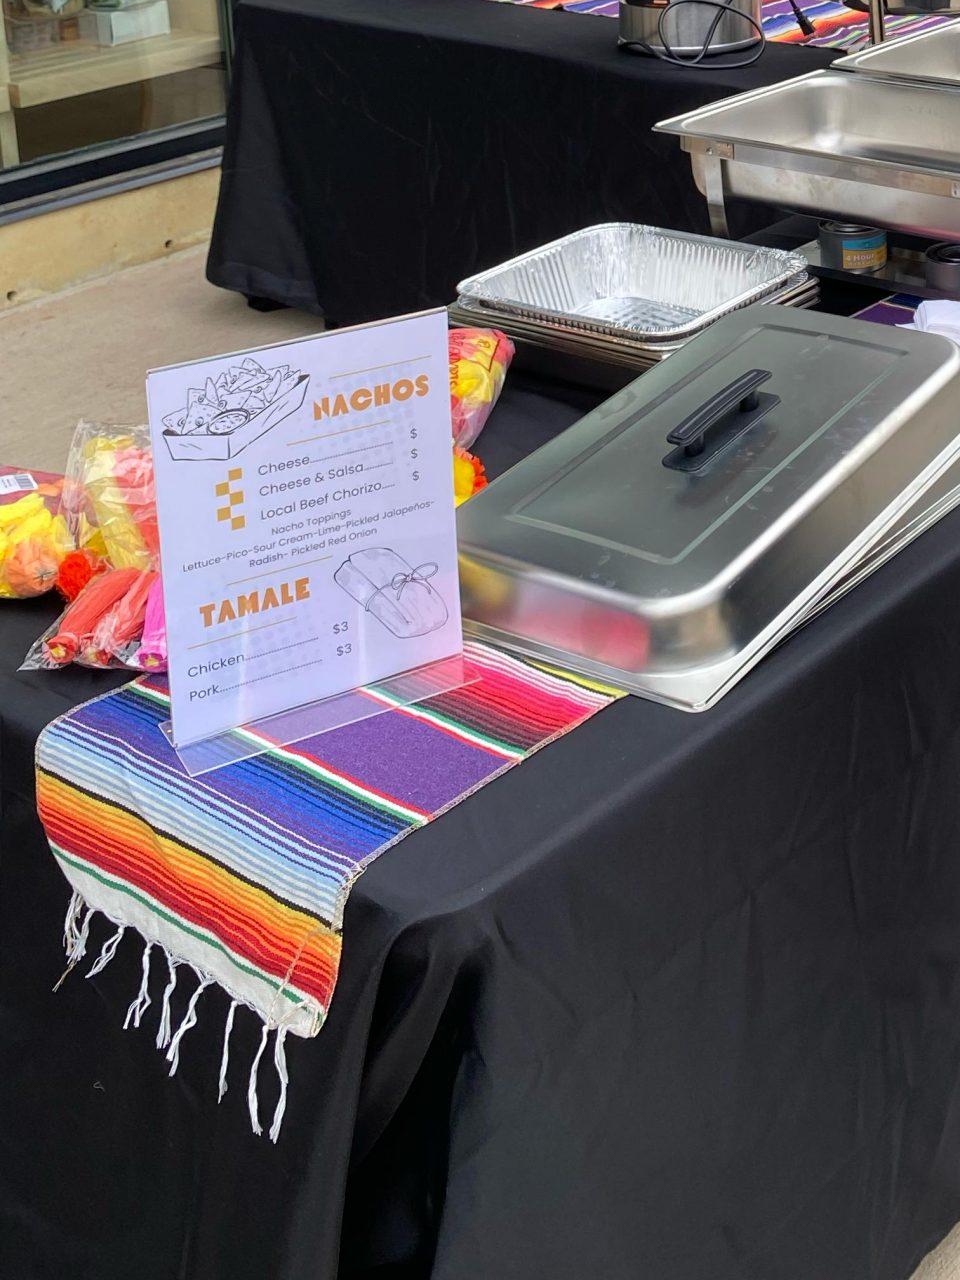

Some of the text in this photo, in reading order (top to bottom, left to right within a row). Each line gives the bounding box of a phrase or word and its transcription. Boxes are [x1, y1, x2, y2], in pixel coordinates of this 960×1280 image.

[313, 374, 429, 421] NACHOS
[258, 427, 418, 476] Cheese $
[259, 448, 418, 497] Cheese & Salsa $
[260, 470, 420, 521] Local Beef Chorizo $
[271, 509, 352, 535] Nacho Toppings
[249, 527, 377, 568] Radish- Pickled Red Onion
[199, 577, 310, 628] TAMALE
[187, 621, 349, 678] Chicken $3
[189, 643, 352, 702] Pork $3
